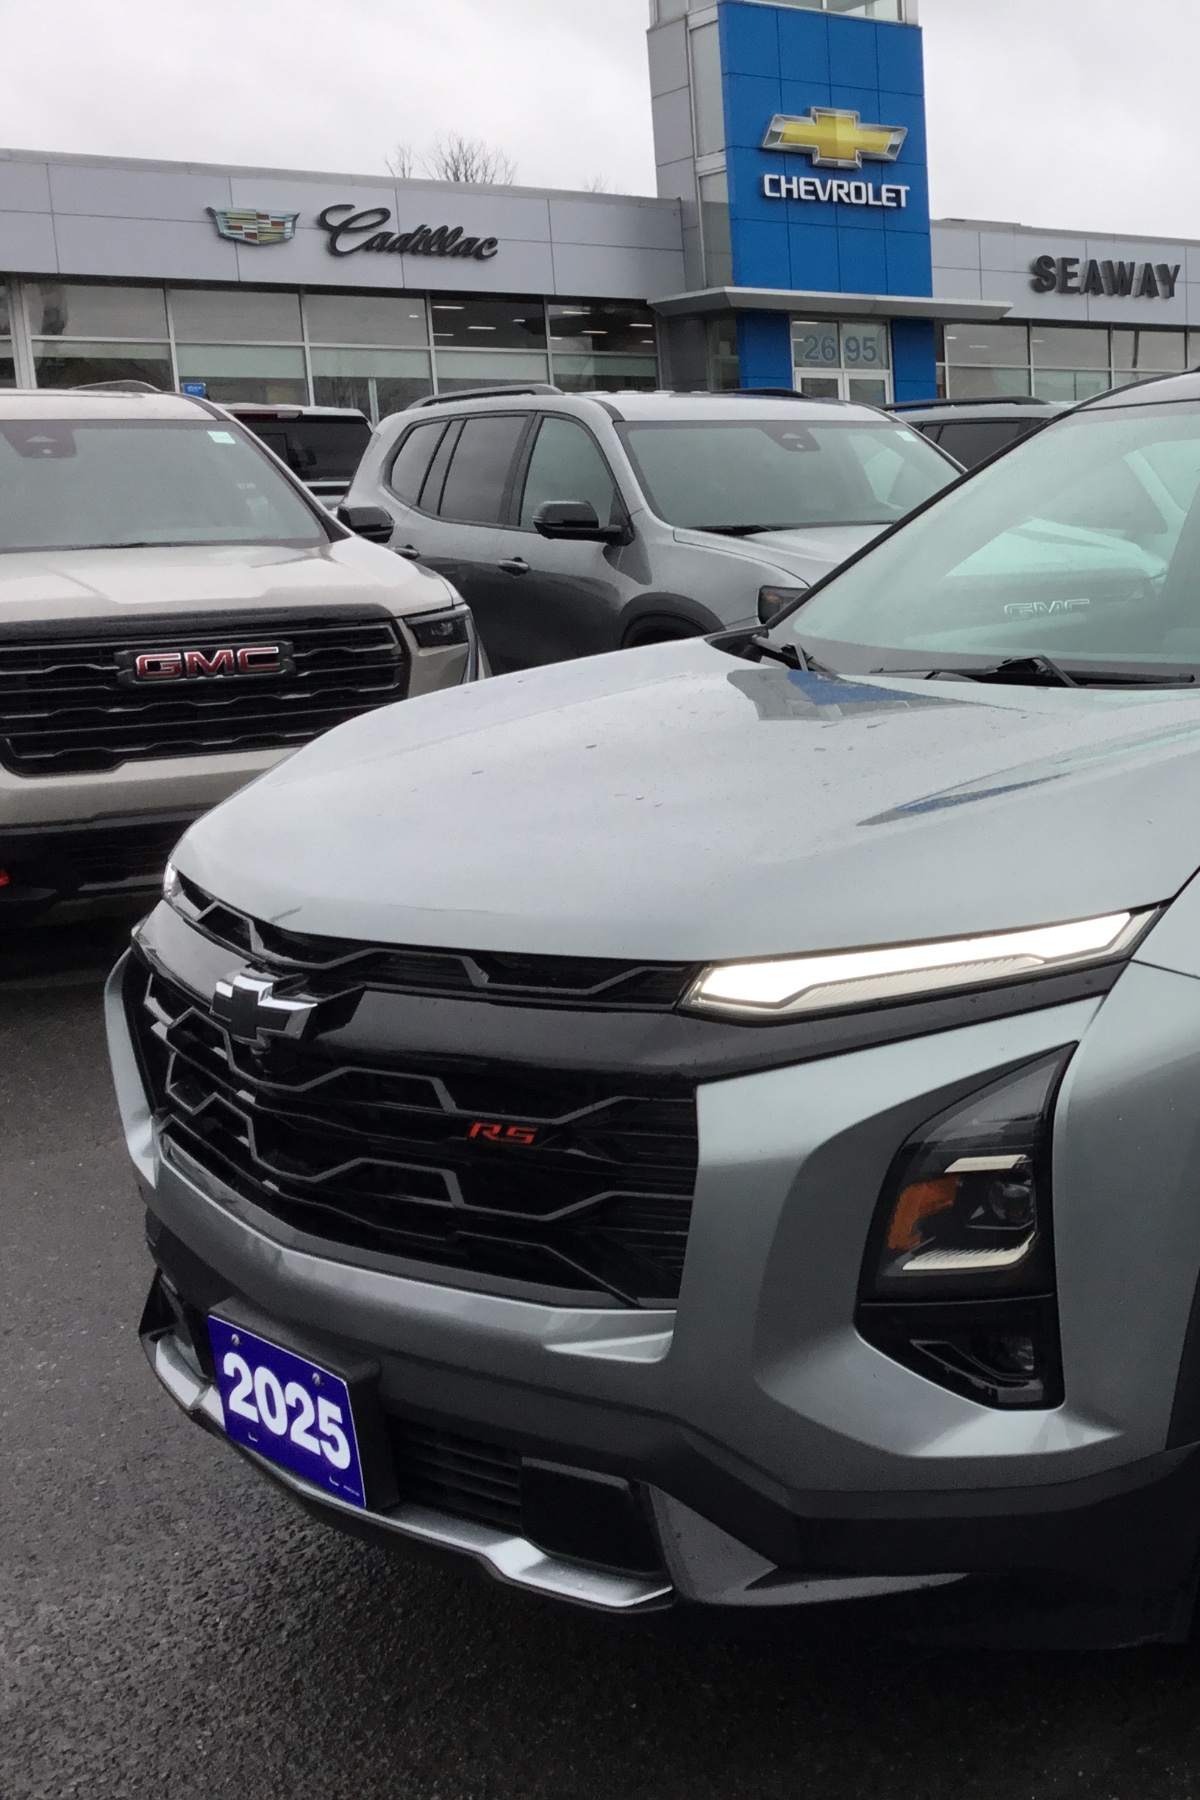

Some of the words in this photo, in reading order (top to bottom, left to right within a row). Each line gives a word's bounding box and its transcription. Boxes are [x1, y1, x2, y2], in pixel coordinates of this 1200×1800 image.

[763, 173, 910, 208] CHEVROLET
[315, 203, 499, 260] Cadillac
[1029, 255, 1181, 298] SEAWAY
[135, 646, 281, 679] GMC
[469, 1122, 538, 1144] RS
[222, 1351, 351, 1470] 2025
